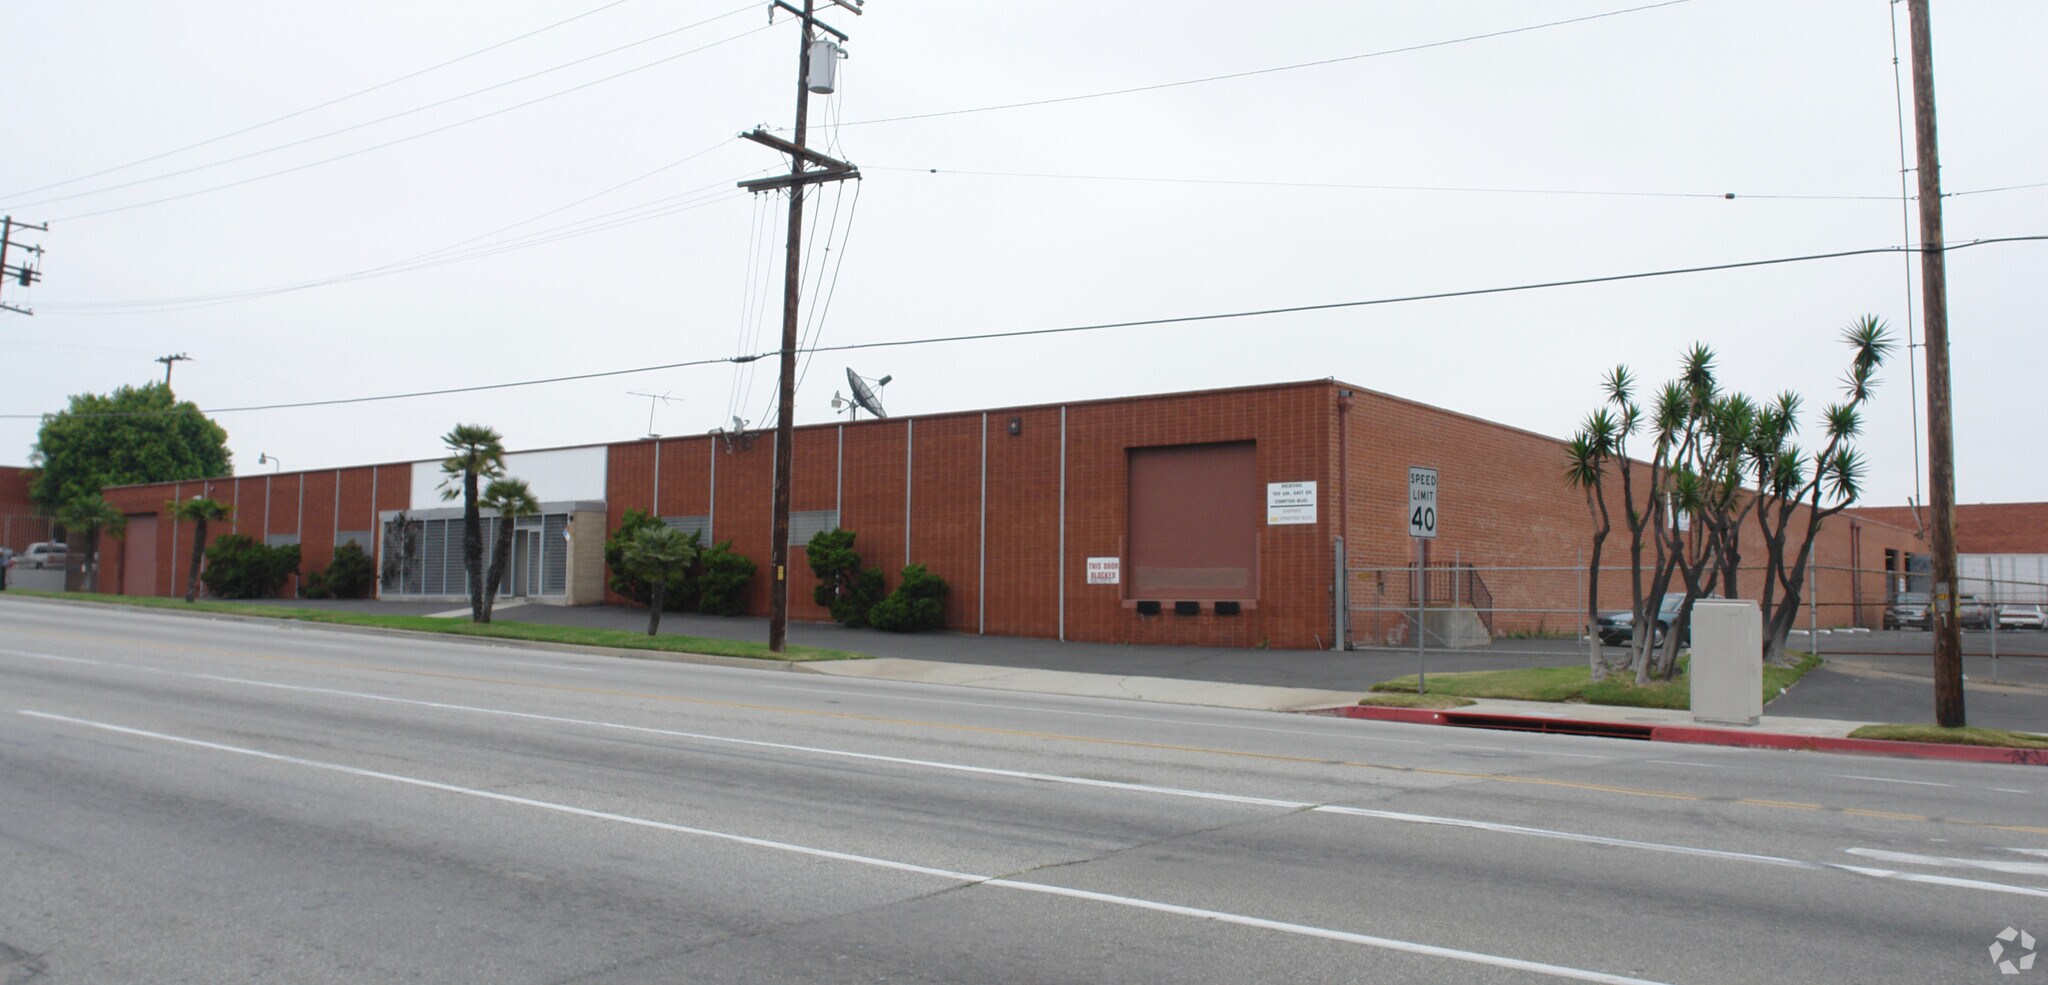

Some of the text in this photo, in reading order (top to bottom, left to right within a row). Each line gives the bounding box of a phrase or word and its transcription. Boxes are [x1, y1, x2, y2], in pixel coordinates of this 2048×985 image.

[1410, 473, 1436, 486] SPEED
[1413, 490, 1434, 502] LIMIT
[1411, 506, 1435, 532] 40
[1089, 562, 1118, 570] THIS DOOR
